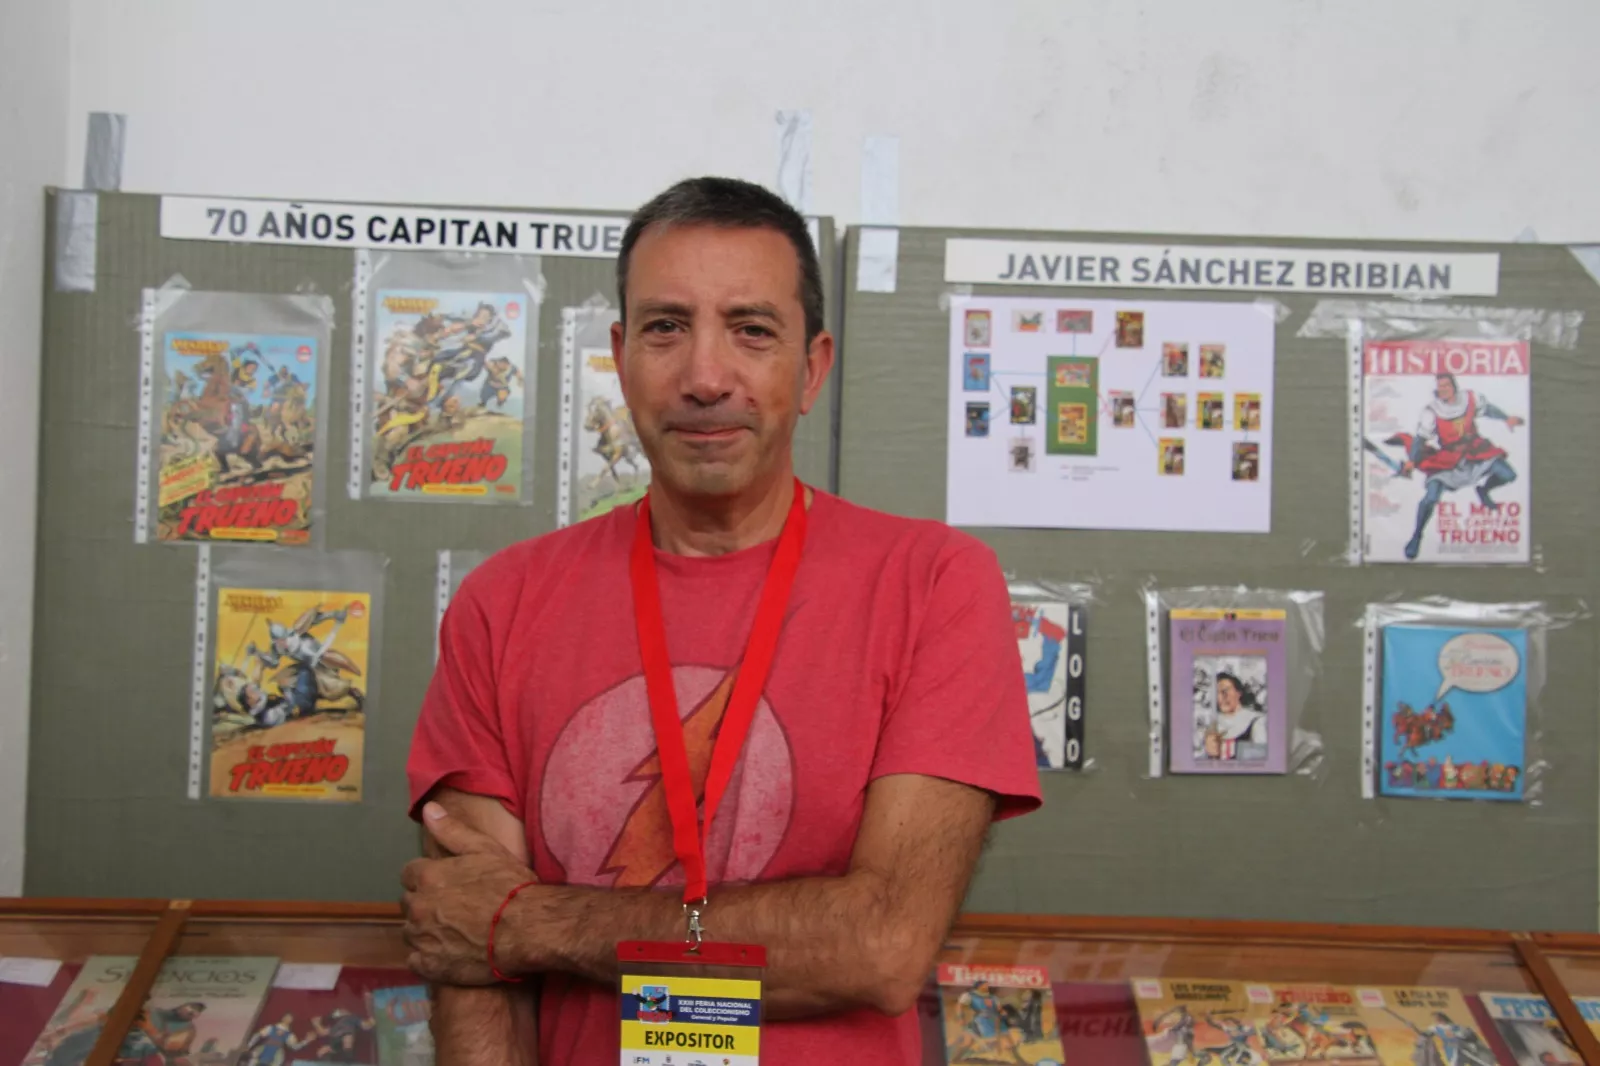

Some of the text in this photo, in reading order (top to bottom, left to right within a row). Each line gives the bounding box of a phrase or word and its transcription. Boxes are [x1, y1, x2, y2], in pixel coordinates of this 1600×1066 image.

[206, 203, 622, 252] 70 AÑOS CAPITAN TRUE
[997, 249, 1452, 290] JAVIER SÁNCHEZ BRIBIAN
[1369, 347, 1525, 374] HISTORIA
[389, 453, 508, 491] TRUENO
[177, 498, 298, 535] TRUENO
[1438, 501, 1520, 517] EL MITO
[1440, 529, 1520, 544] TRUENO
[1066, 611, 1084, 763] LOGO
[228, 754, 349, 791] TRUENO
[694, 1007, 751, 1016] COLECCIONISMO
[695, 1000, 716, 1008] FERIA
[717, 1001, 752, 1010] NACIONAL
[645, 1030, 735, 1050] EXPOSITOR
